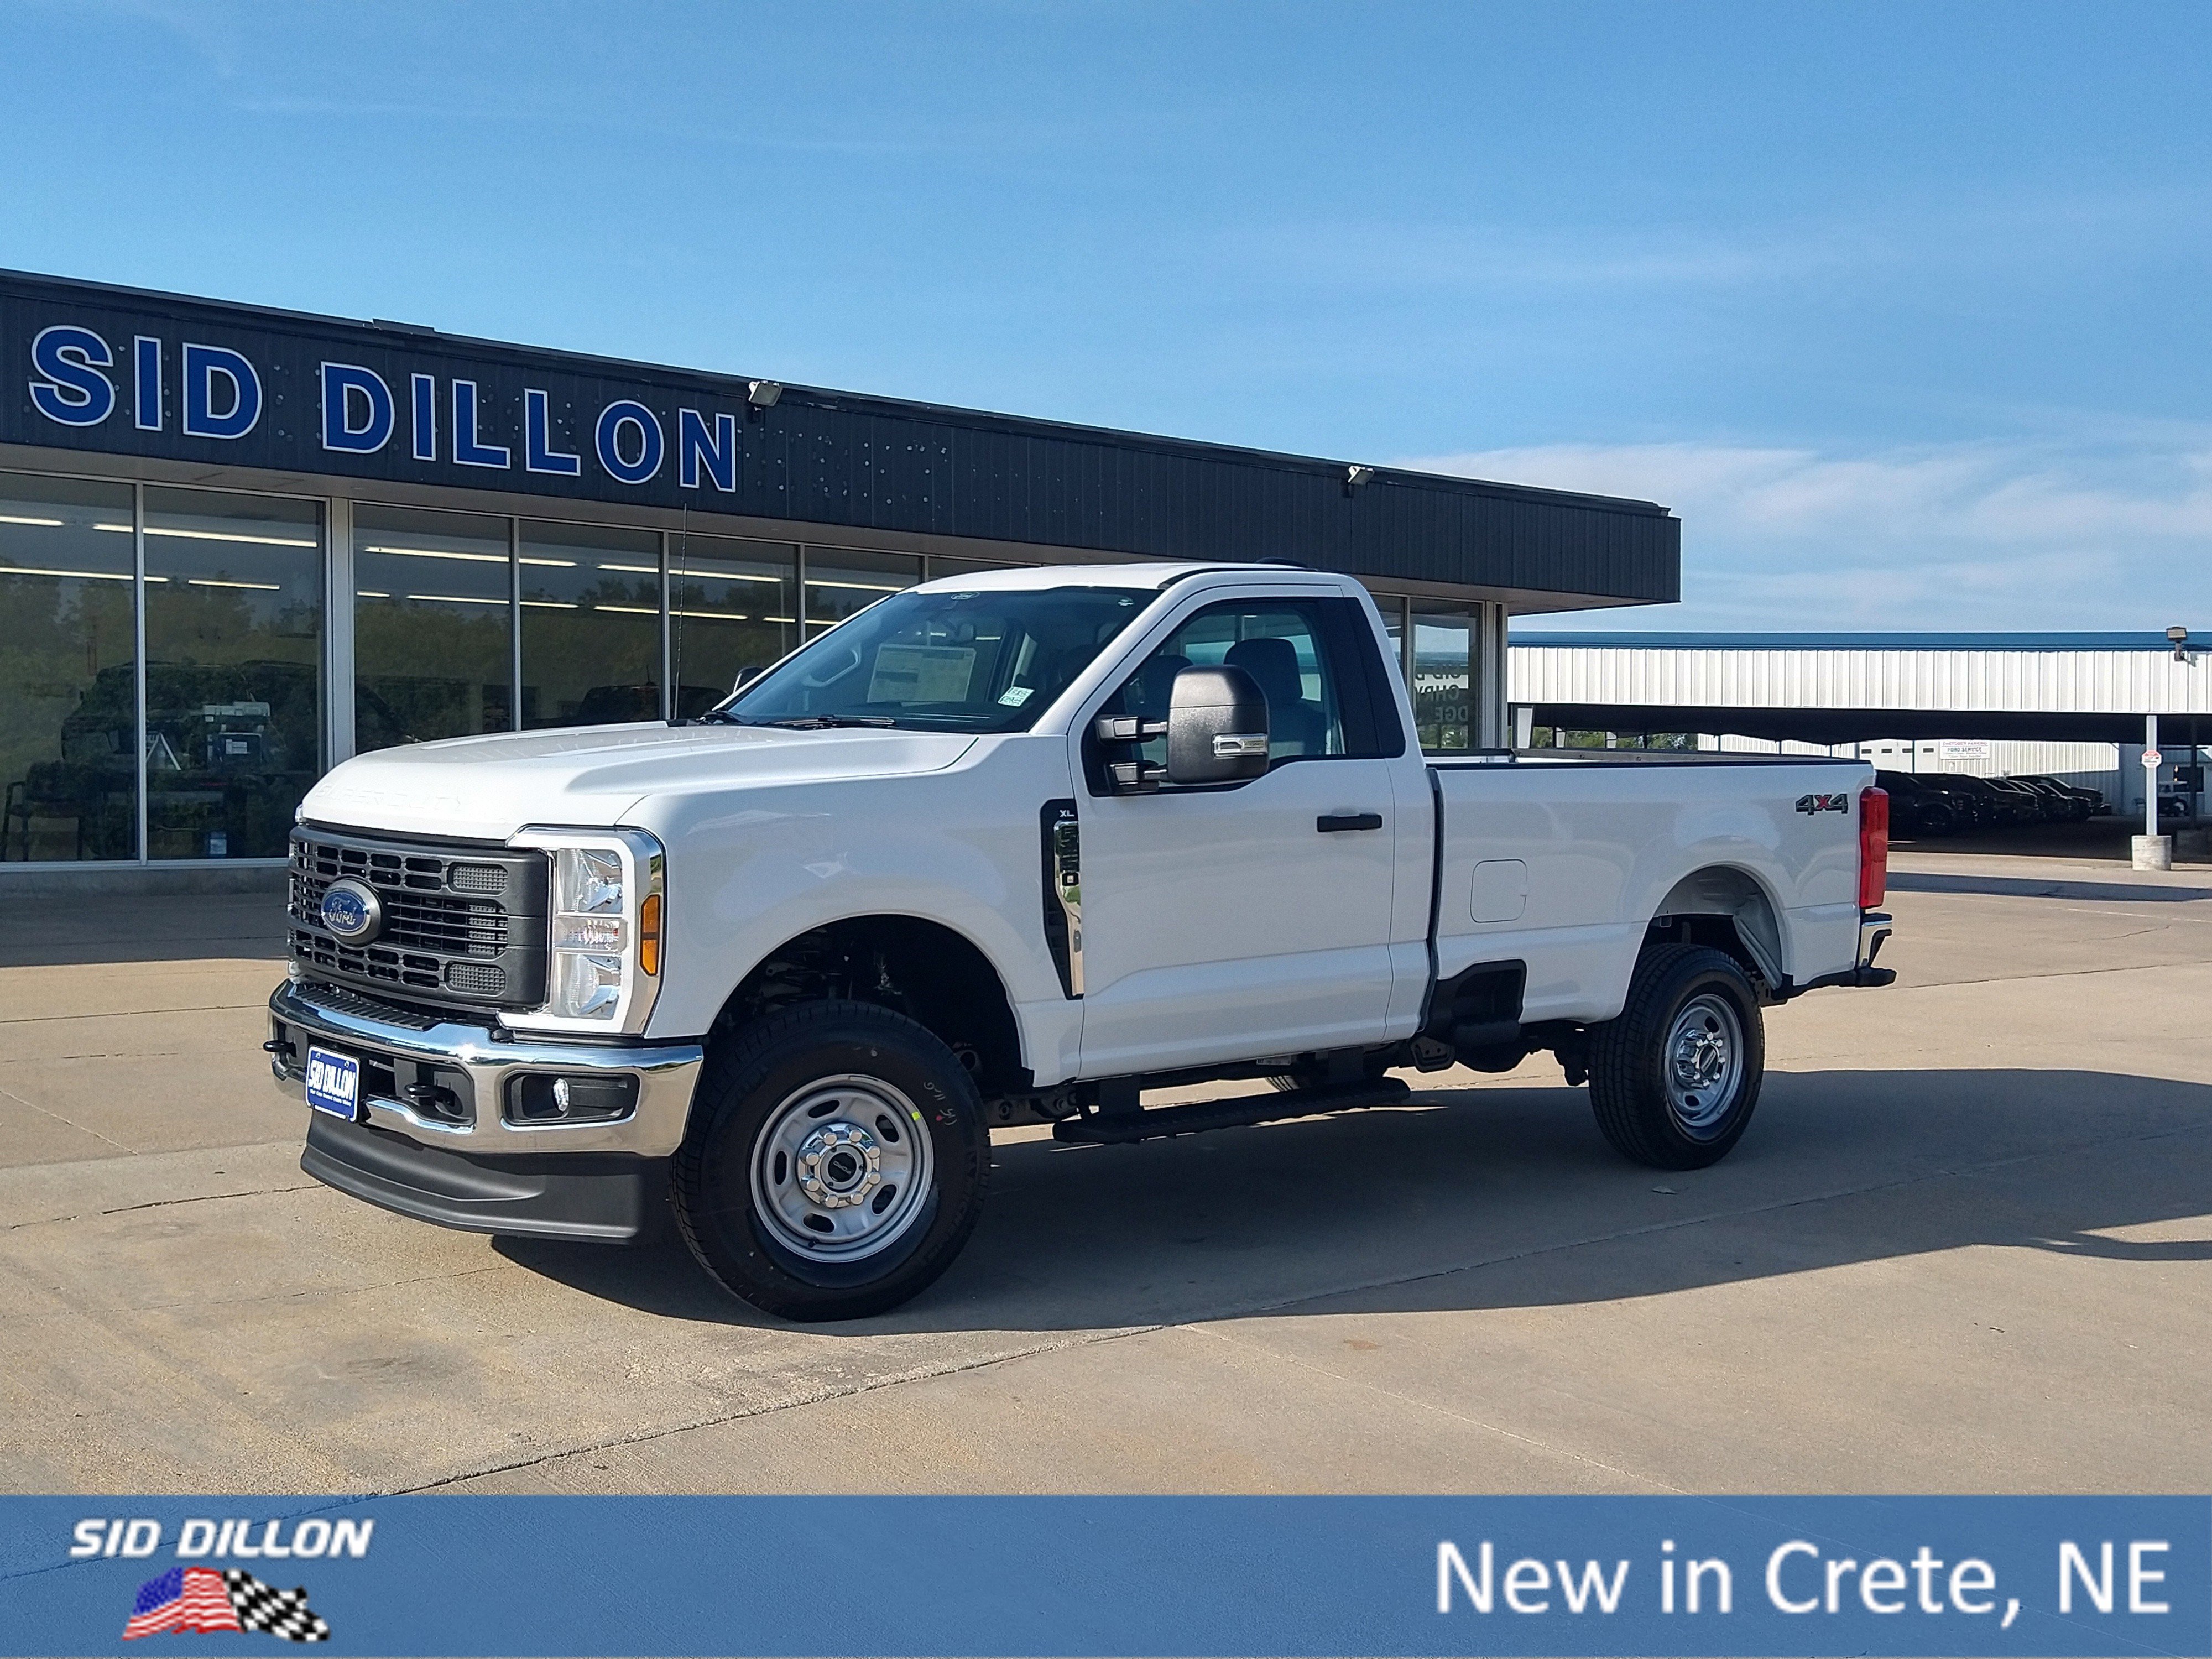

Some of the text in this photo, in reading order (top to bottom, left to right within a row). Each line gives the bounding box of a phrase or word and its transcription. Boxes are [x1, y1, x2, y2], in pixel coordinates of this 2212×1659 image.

[29, 325, 736, 493] SID DILLON
[328, 896, 356, 926] Ford
[308, 1059, 324, 1091] SID
[322, 1063, 356, 1100] DILLON
